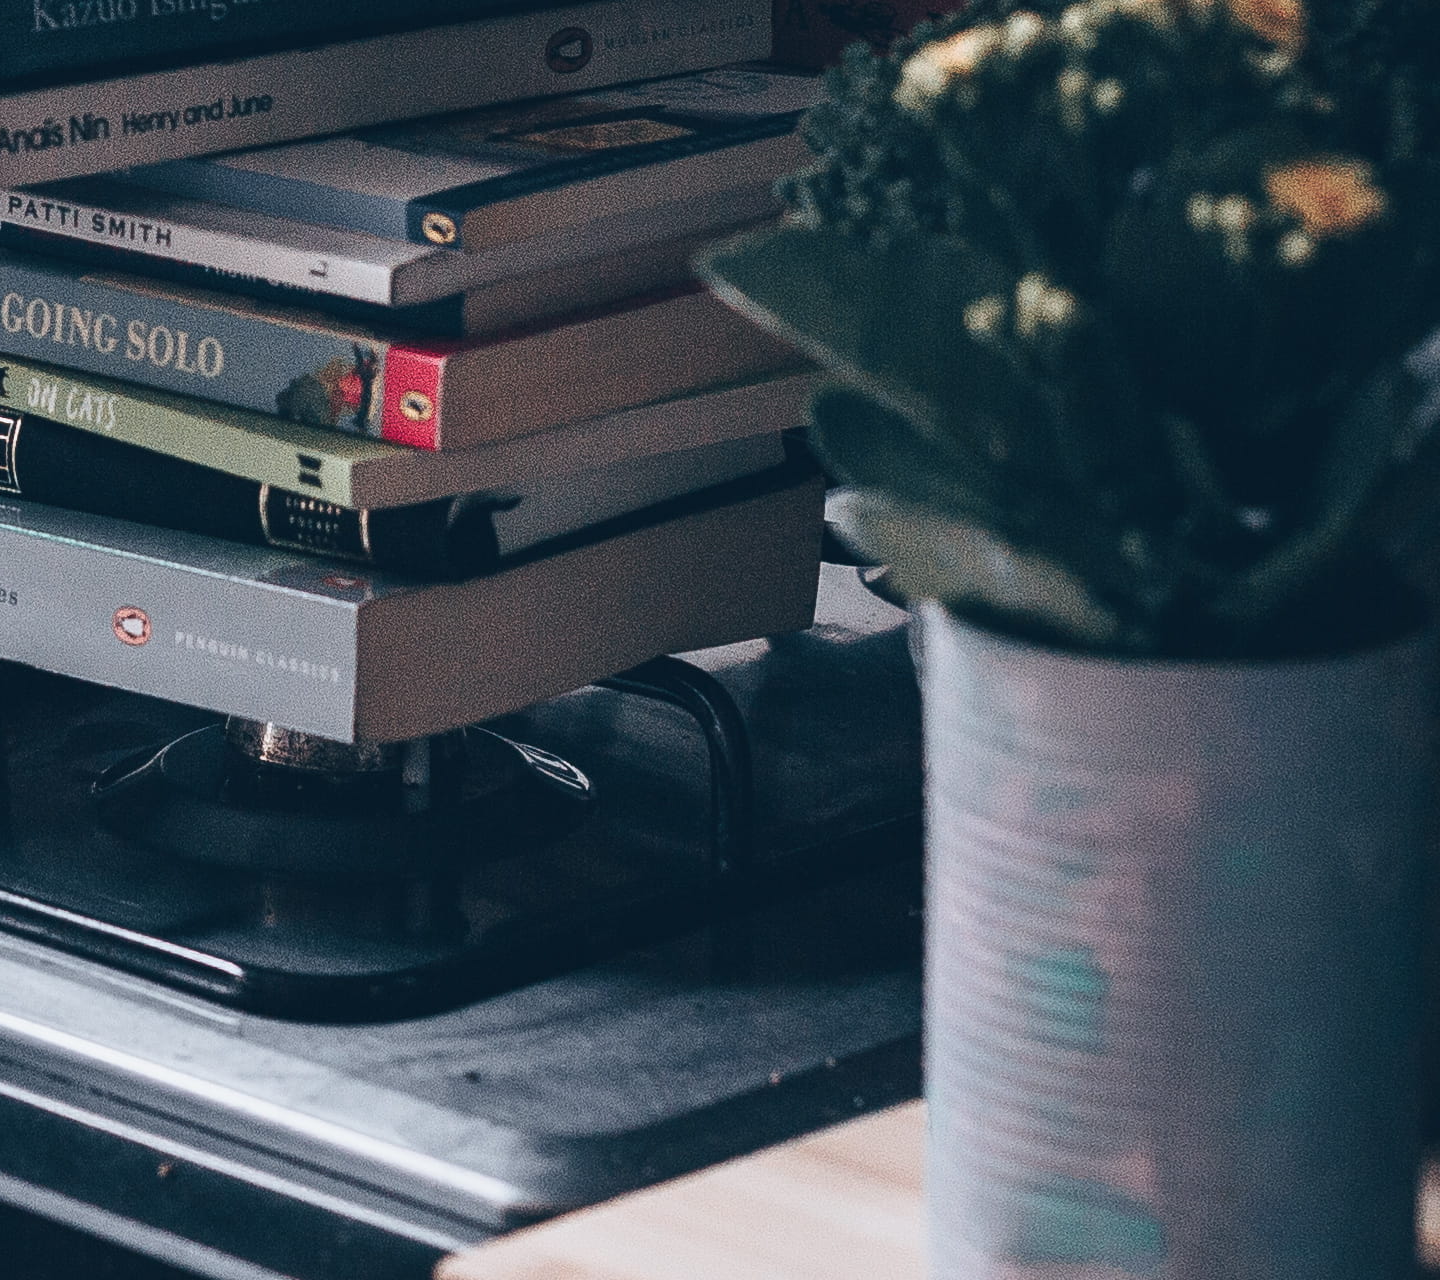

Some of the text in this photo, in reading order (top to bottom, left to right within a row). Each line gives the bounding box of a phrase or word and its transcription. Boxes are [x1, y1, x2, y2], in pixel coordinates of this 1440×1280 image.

[68, 111, 110, 144] Nin
[121, 104, 180, 138] Henry
[183, 98, 224, 125] and
[225, 93, 273, 120] June
[8, 194, 173, 248] PATTI SMITH
[0, 291, 119, 354] GOING
[125, 320, 225, 379] SOLO
[27, 375, 58, 417] ON
[66, 383, 118, 432] CATS
[174, 629, 342, 685] PENGUIN CLASSICS
